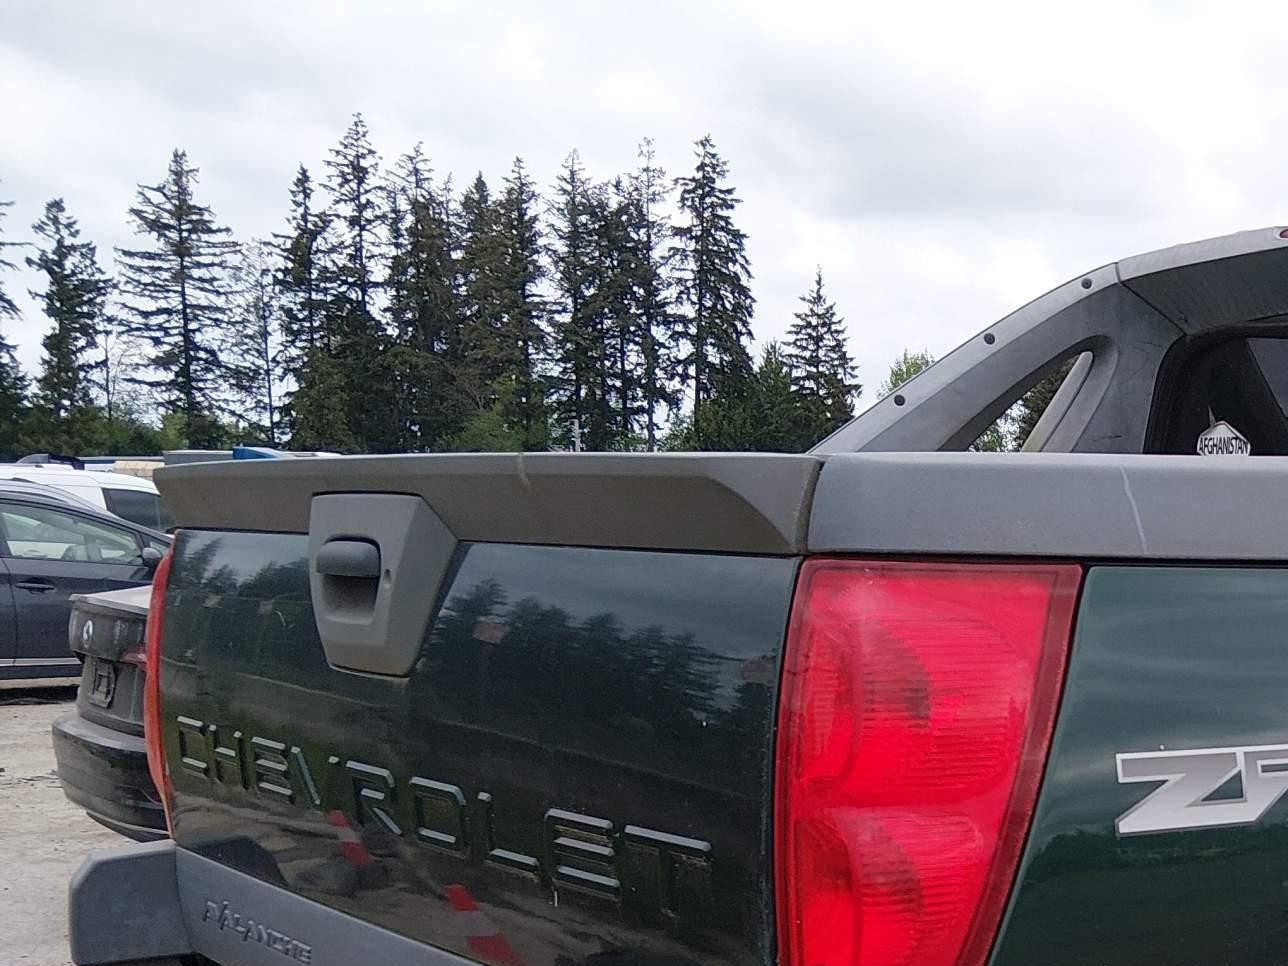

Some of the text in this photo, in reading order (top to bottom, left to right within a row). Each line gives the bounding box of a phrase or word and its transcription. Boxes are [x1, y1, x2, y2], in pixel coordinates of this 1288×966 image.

[1199, 436, 1249, 455] AFGHANISTAN
[176, 714, 713, 914] CHEVROLET
[202, 900, 312, 966] AVALANCHE
